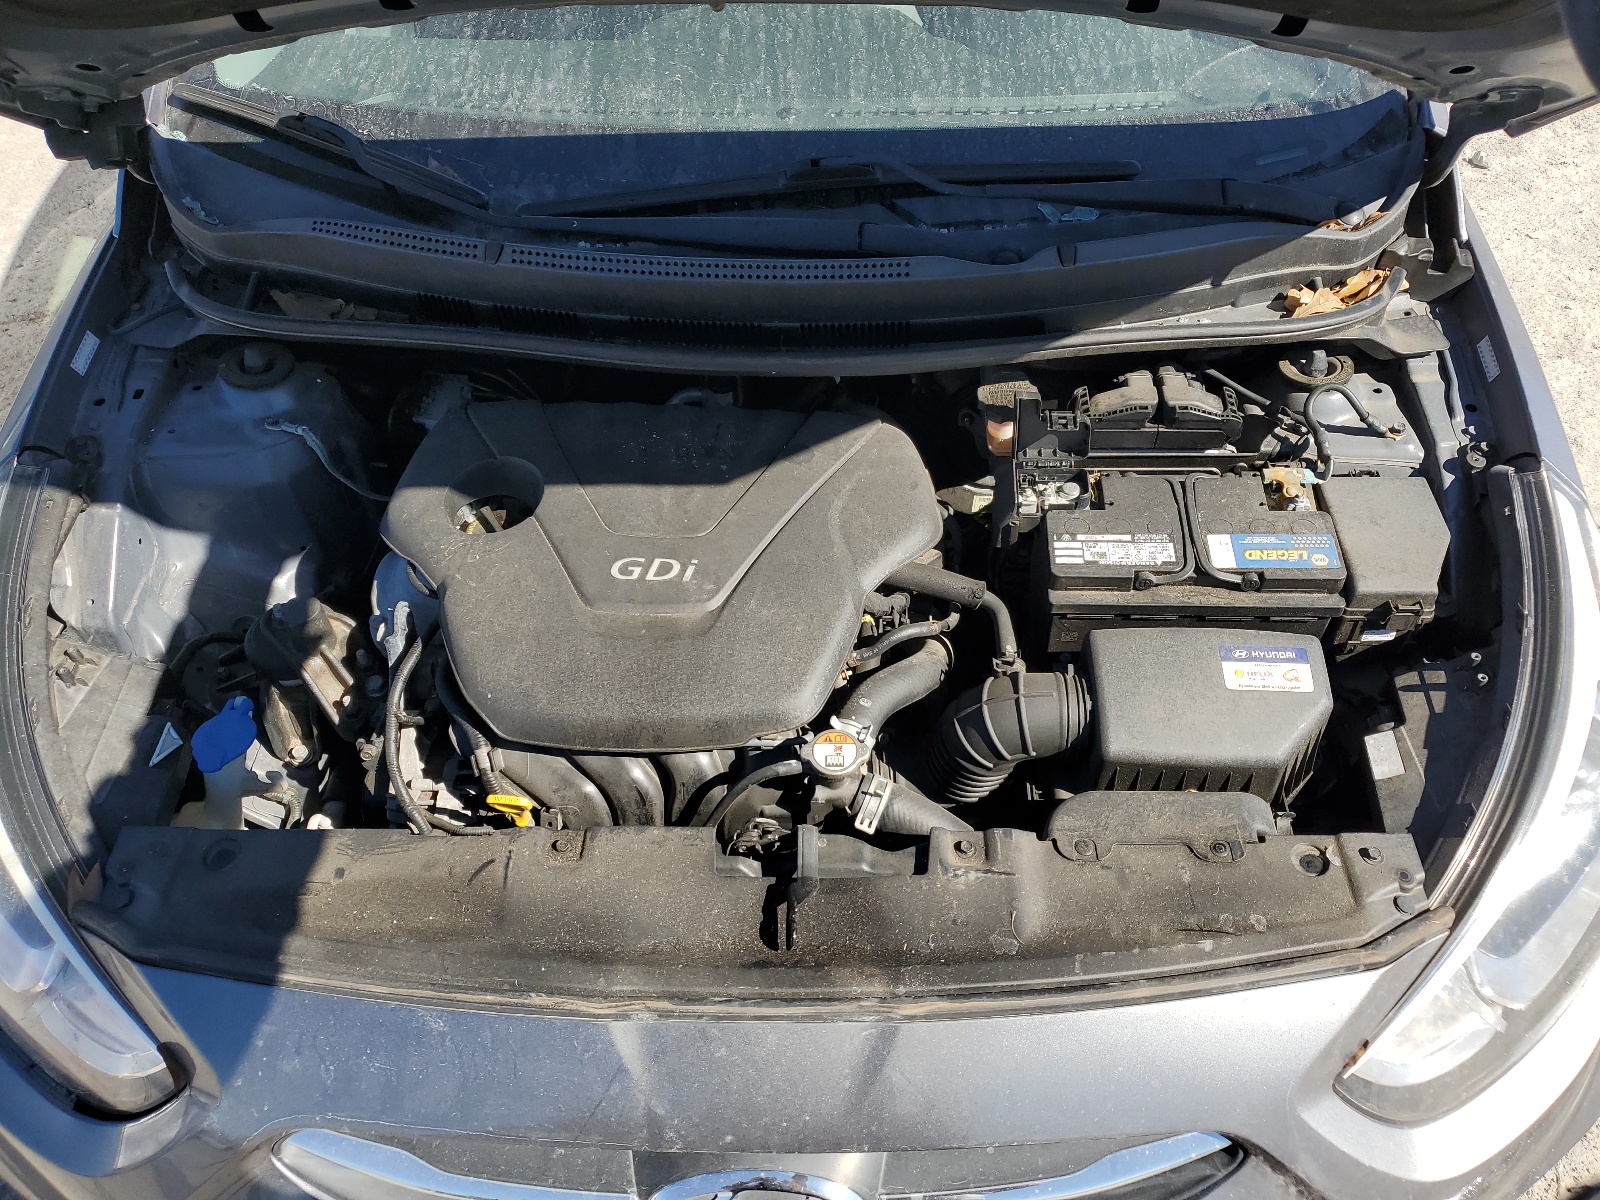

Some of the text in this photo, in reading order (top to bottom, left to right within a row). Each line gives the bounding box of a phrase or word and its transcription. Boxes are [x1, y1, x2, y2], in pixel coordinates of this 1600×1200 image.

[1244, 548, 1309, 560] LEGEND
[610, 557, 699, 582] GDi
[1251, 650, 1296, 659] HYUNDAI
